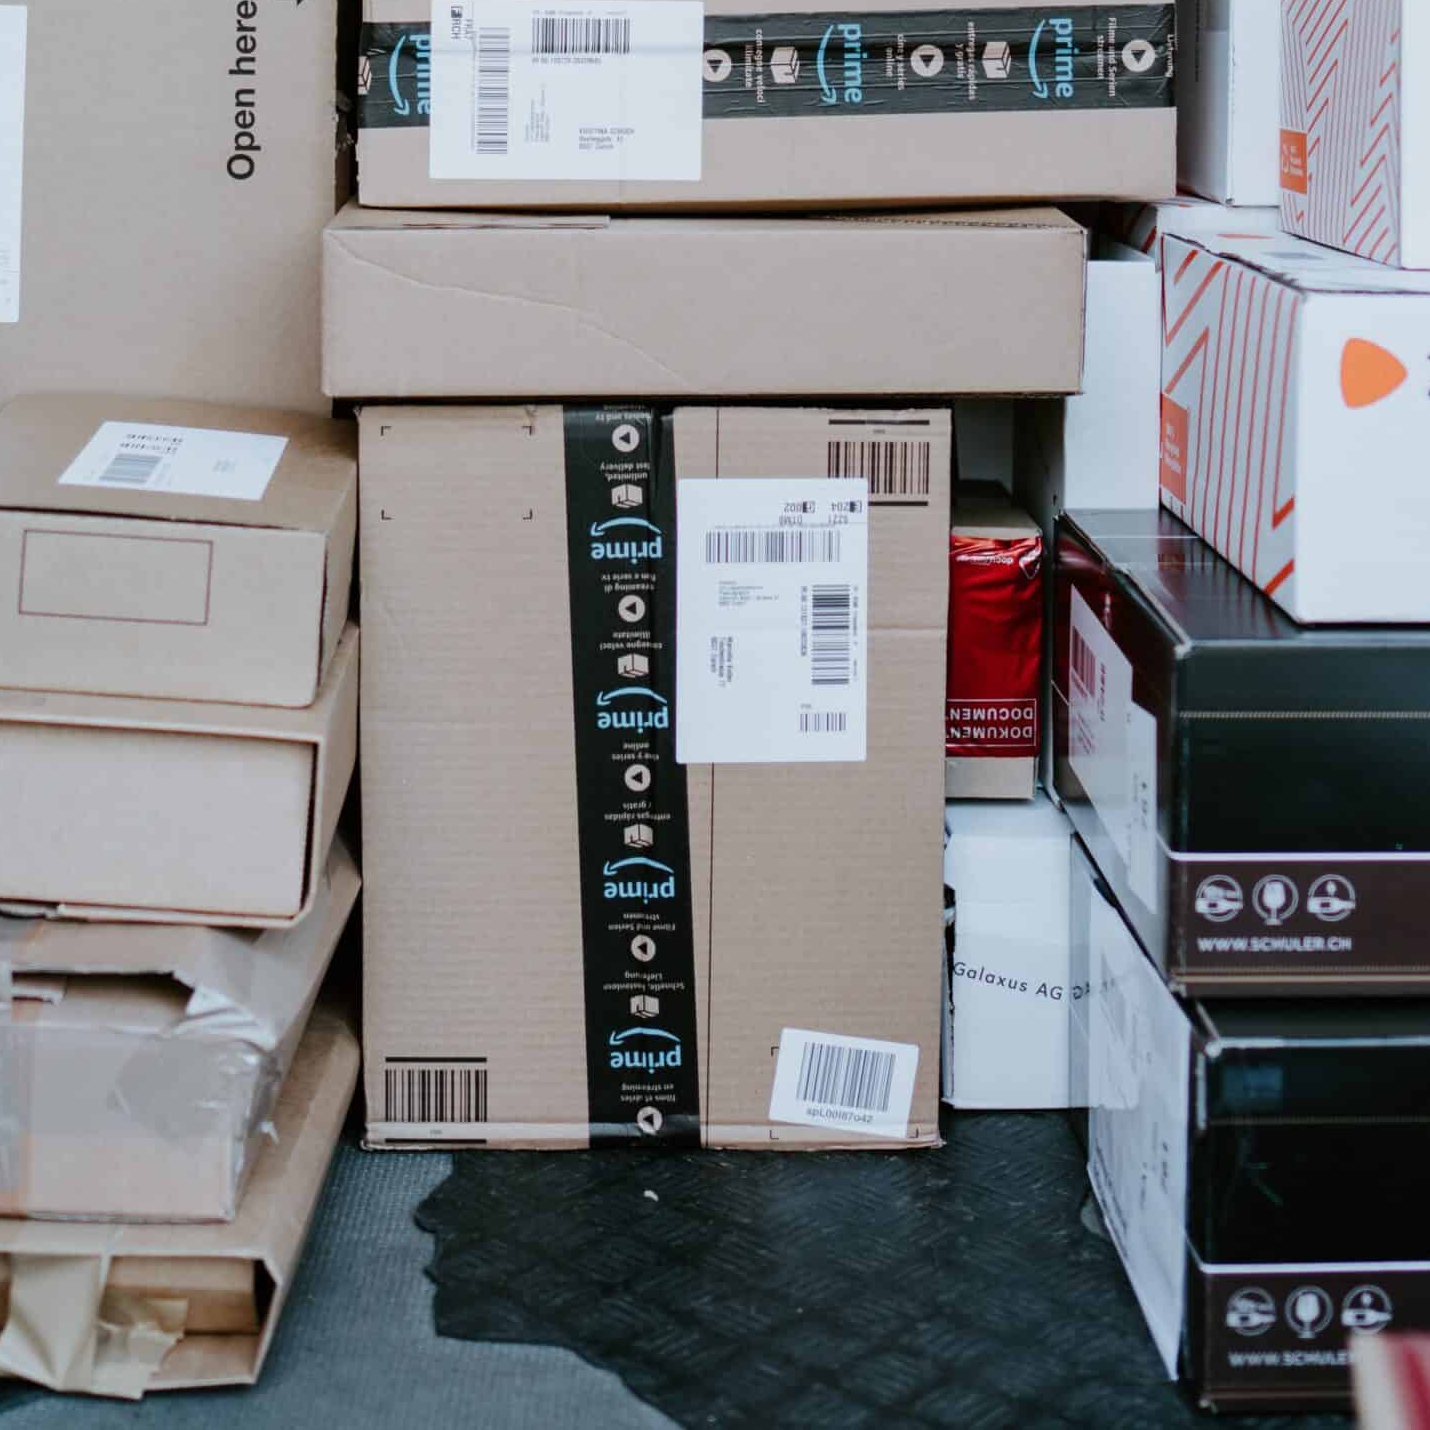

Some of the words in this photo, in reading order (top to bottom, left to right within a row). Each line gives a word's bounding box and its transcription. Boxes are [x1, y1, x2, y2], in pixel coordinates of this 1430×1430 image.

[837, 22, 869, 104] prime
[1049, 17, 1080, 98] prime
[226, 88, 262, 181] Open
[590, 535, 664, 566] prime
[596, 705, 669, 734] prime
[603, 875, 676, 905] prime
[953, 961, 1028, 992] Galaxus
[1035, 982, 1064, 1001] AG
[609, 1044, 683, 1075] prime
